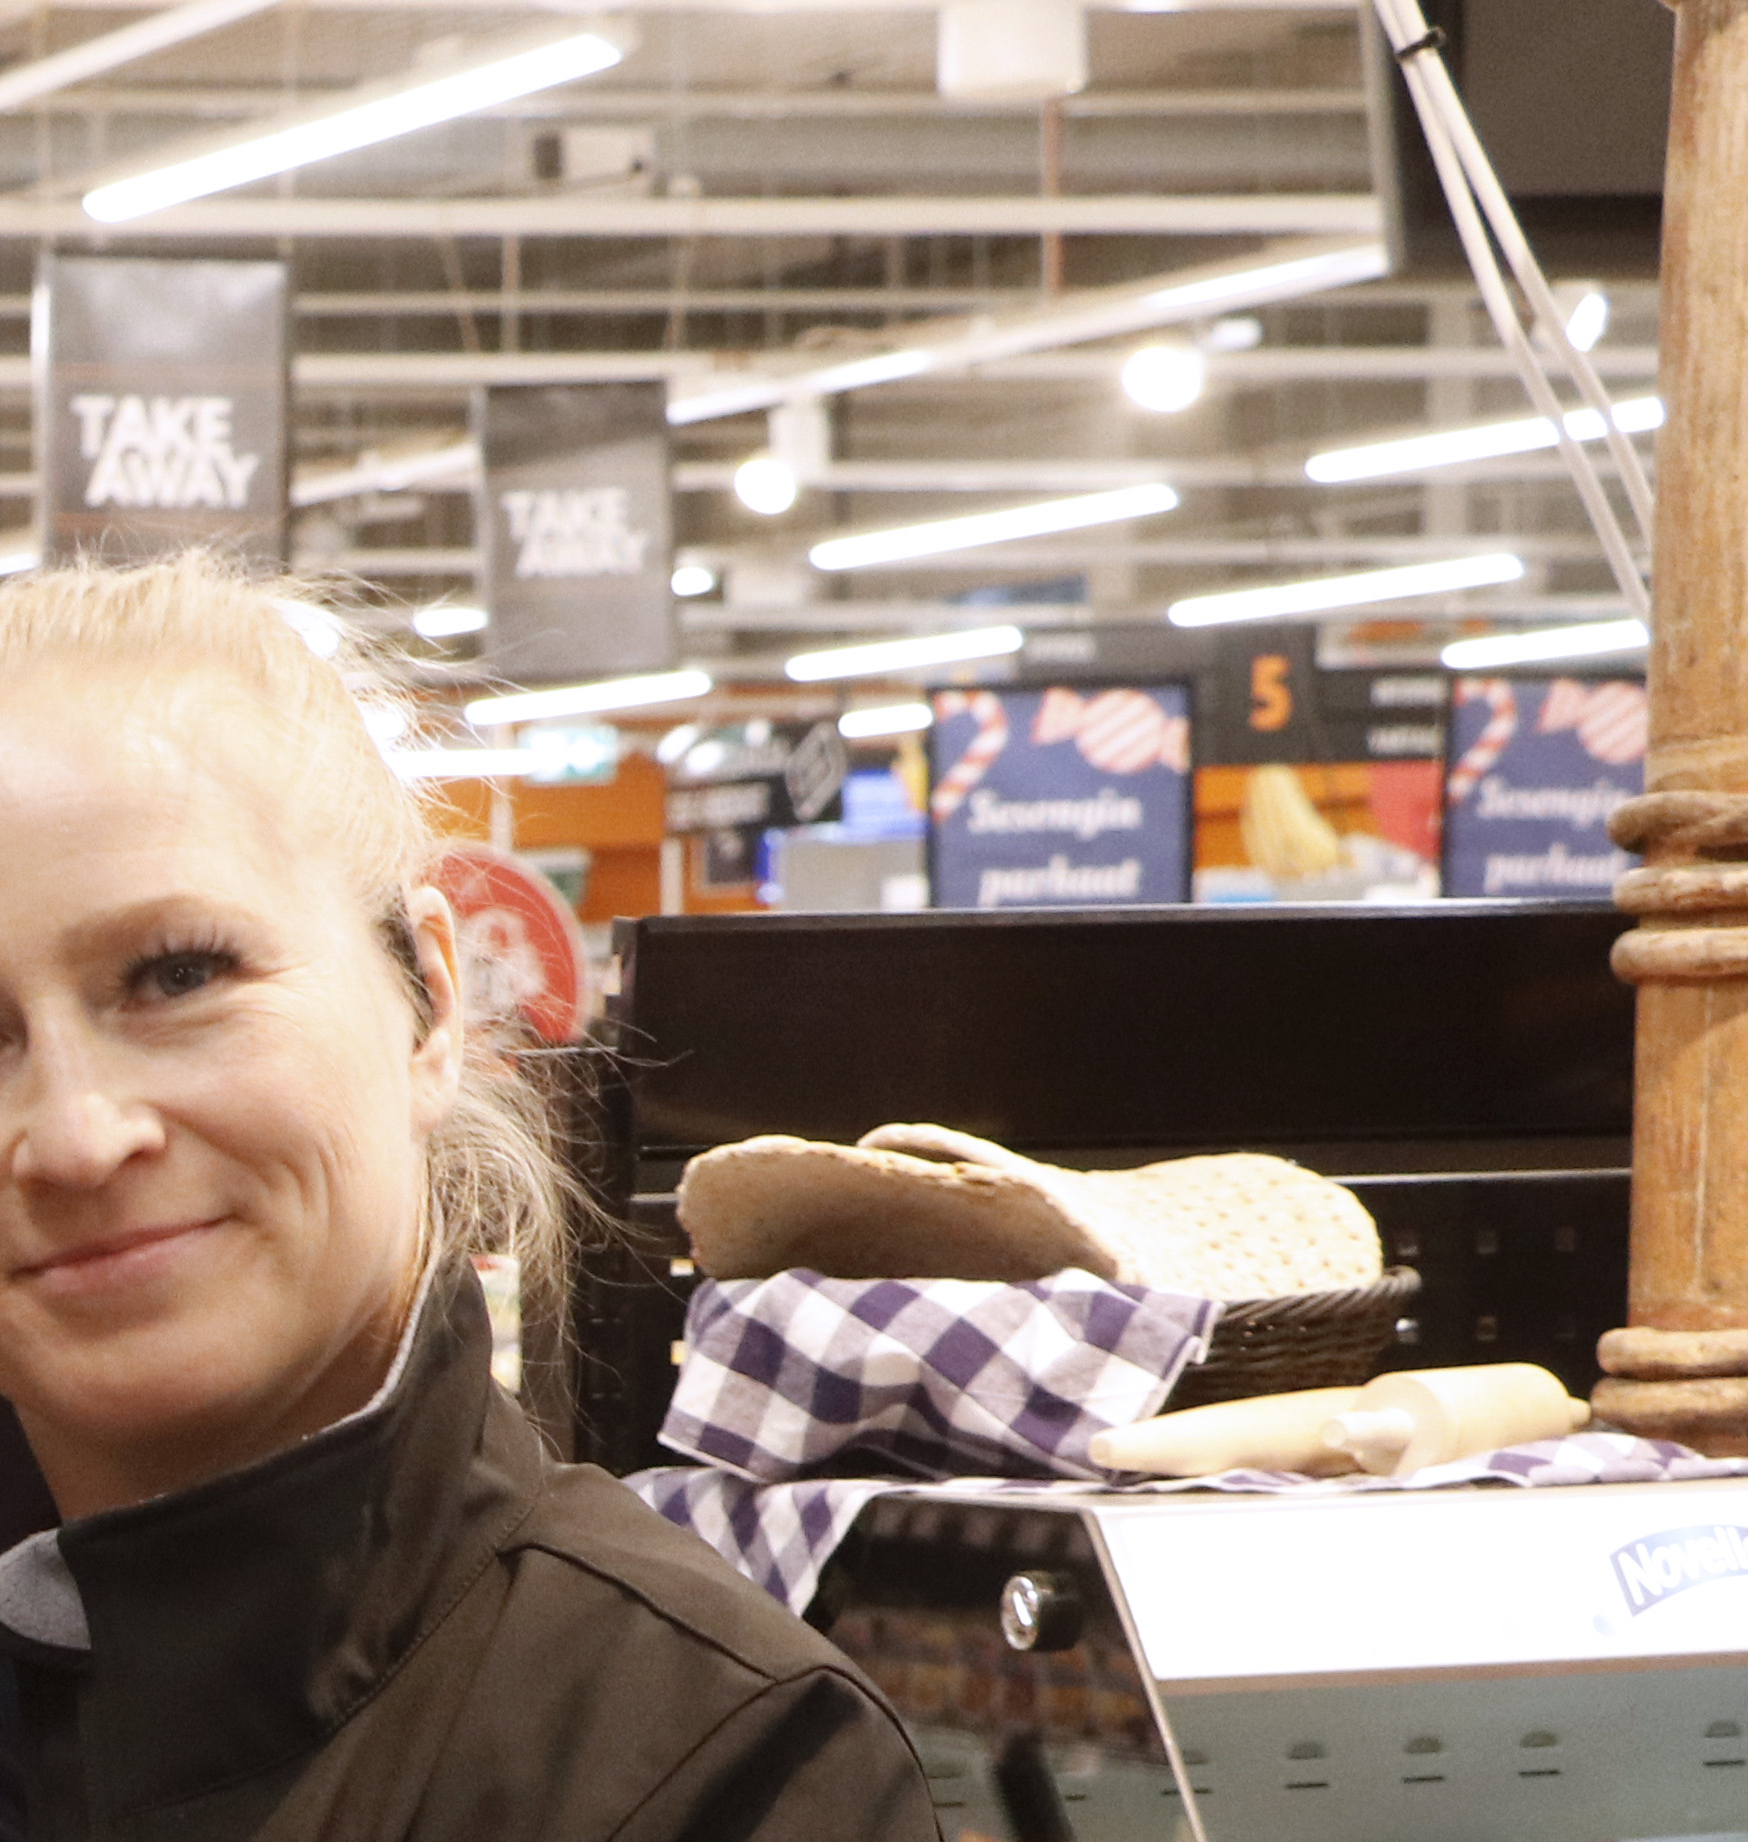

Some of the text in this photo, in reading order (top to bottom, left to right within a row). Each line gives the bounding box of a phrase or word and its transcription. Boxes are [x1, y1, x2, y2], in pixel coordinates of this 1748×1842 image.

[70, 395, 232, 459] TAKE
[85, 452, 259, 508] AWAY
[501, 488, 629, 540] TAKE
[1250, 654, 1293, 732] 5
[1617, 1526, 1748, 1606] Novell
